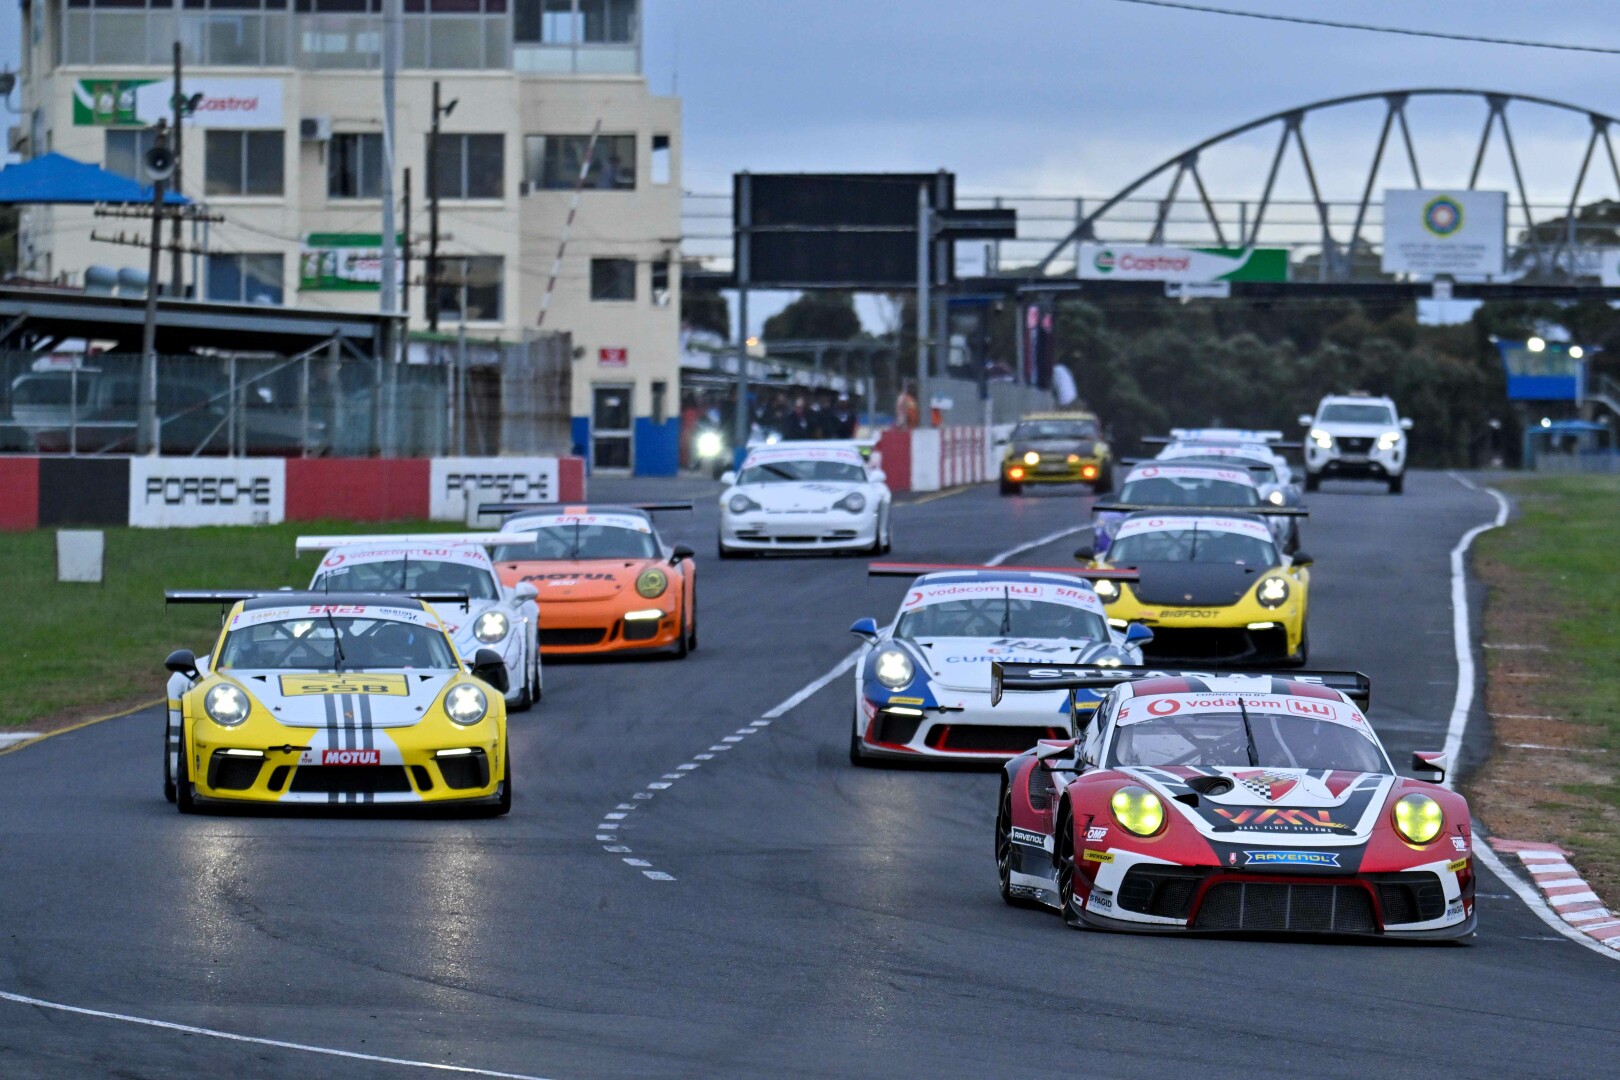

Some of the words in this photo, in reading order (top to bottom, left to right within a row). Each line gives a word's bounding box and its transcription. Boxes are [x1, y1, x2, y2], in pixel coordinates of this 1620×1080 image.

[1119, 254, 1190, 271] Castrol
[146, 477, 270, 505] PORSCHE
[520, 573, 616, 582] MOTUL
[928, 586, 1000, 597] vodacom
[1010, 585, 1037, 594] 4U
[1160, 610, 1220, 618] BIGFOOT
[301, 684, 389, 693] SSB
[1186, 698, 1281, 708] vodacom
[1294, 701, 1330, 716] 4U
[325, 752, 379, 764] MOTUL
[1015, 831, 1043, 845] RAVENOL
[1087, 829, 1107, 840] OMP
[1088, 852, 1112, 861] DUNLOP
[1254, 853, 1331, 863] RAVENOL
[1095, 895, 1112, 908] PAGID
